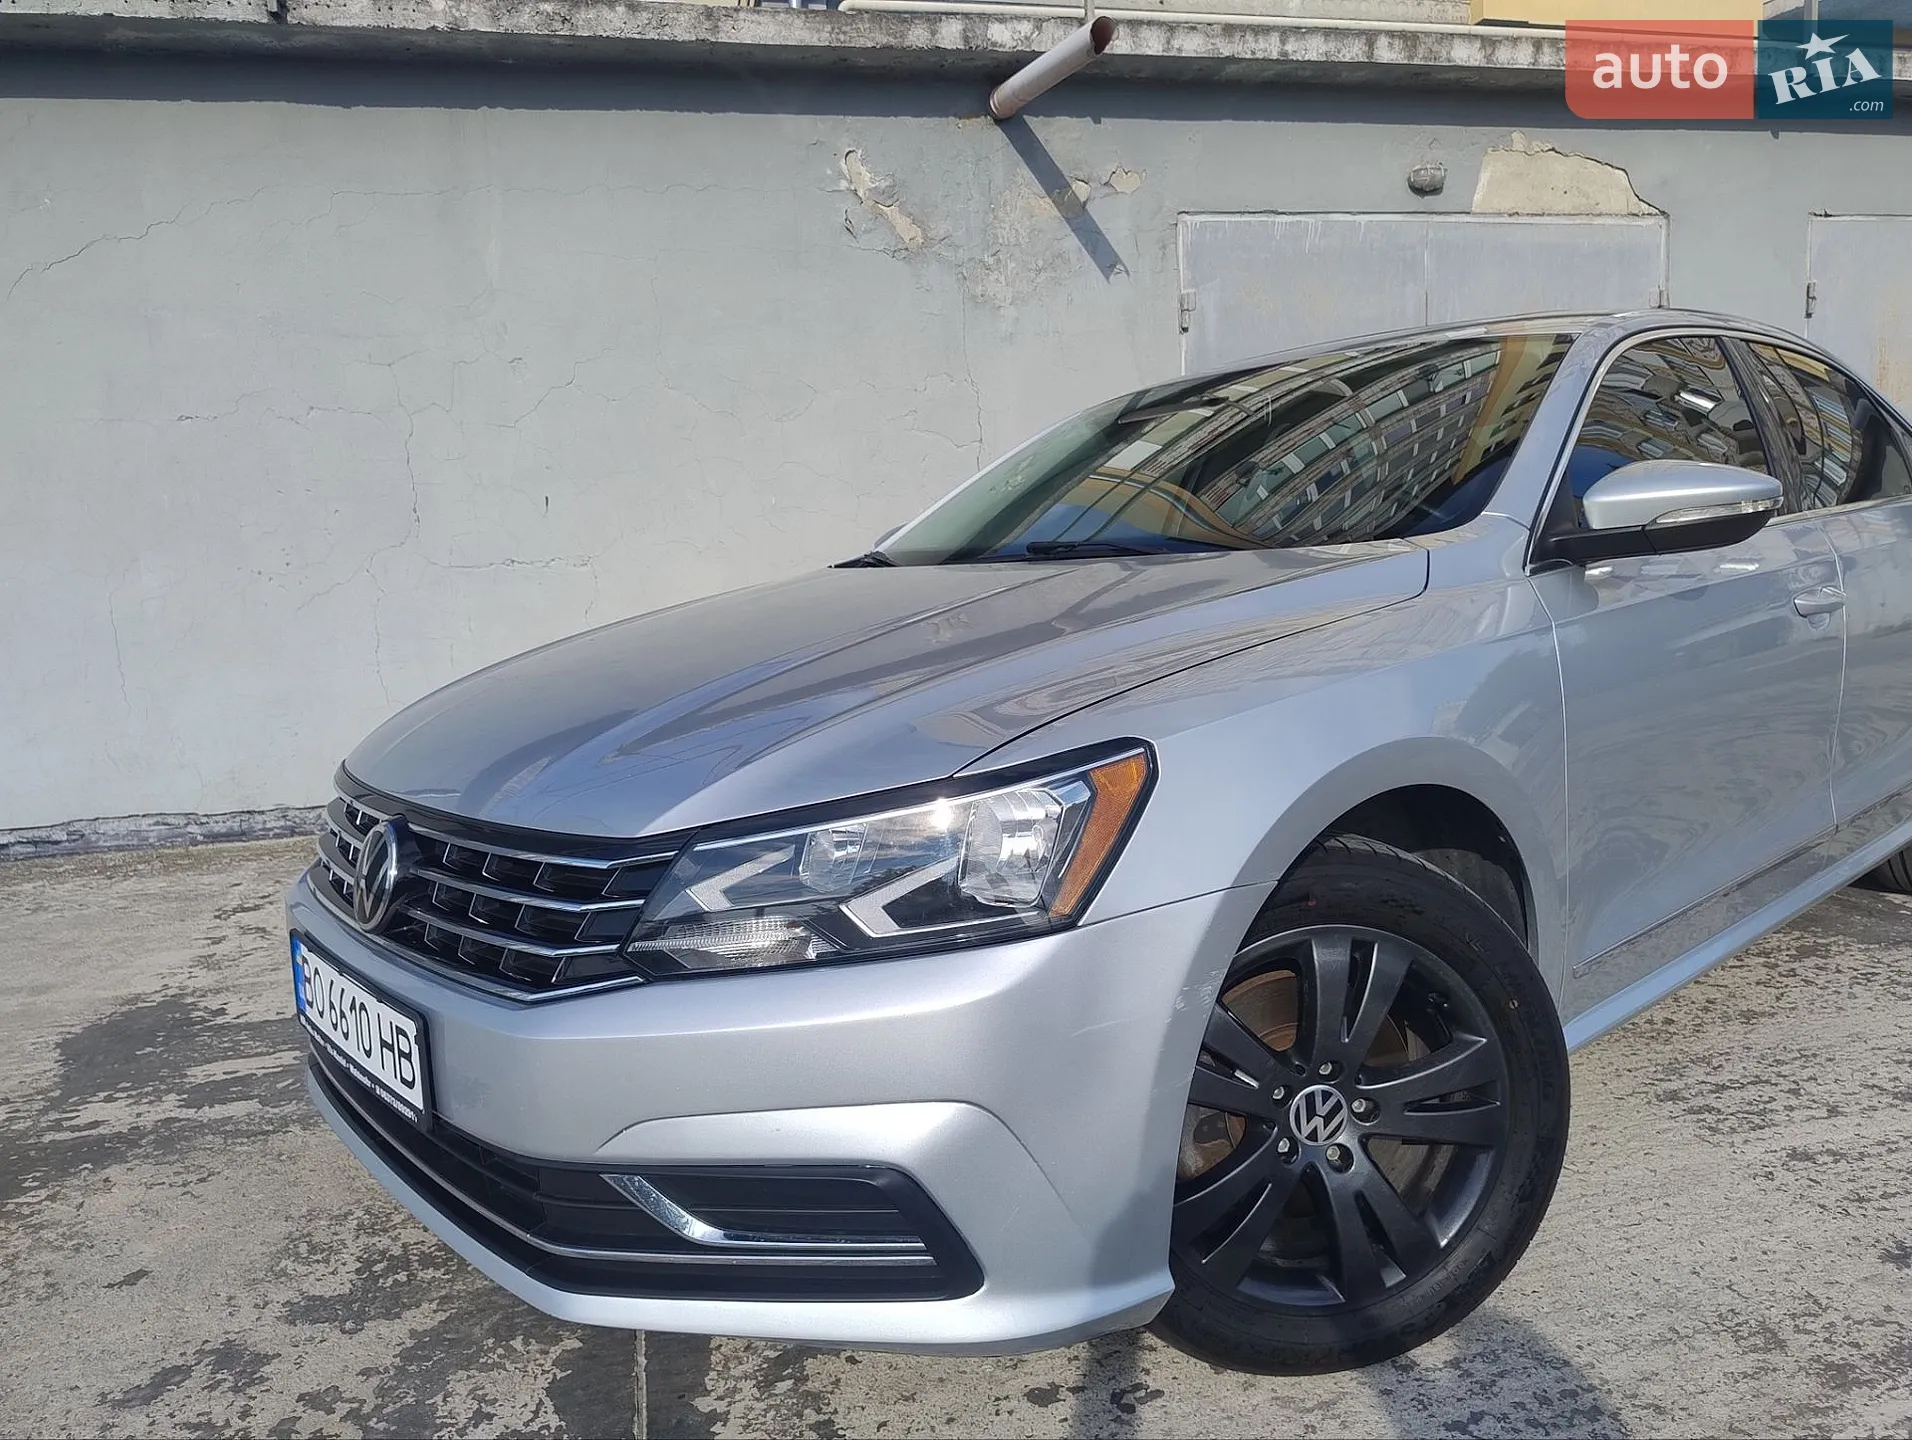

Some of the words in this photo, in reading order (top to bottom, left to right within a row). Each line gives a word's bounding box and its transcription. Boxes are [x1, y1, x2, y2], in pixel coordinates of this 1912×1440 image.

[302, 955, 325, 1019] BO
[328, 979, 372, 1059] 6610
[377, 1012, 416, 1090] HB
